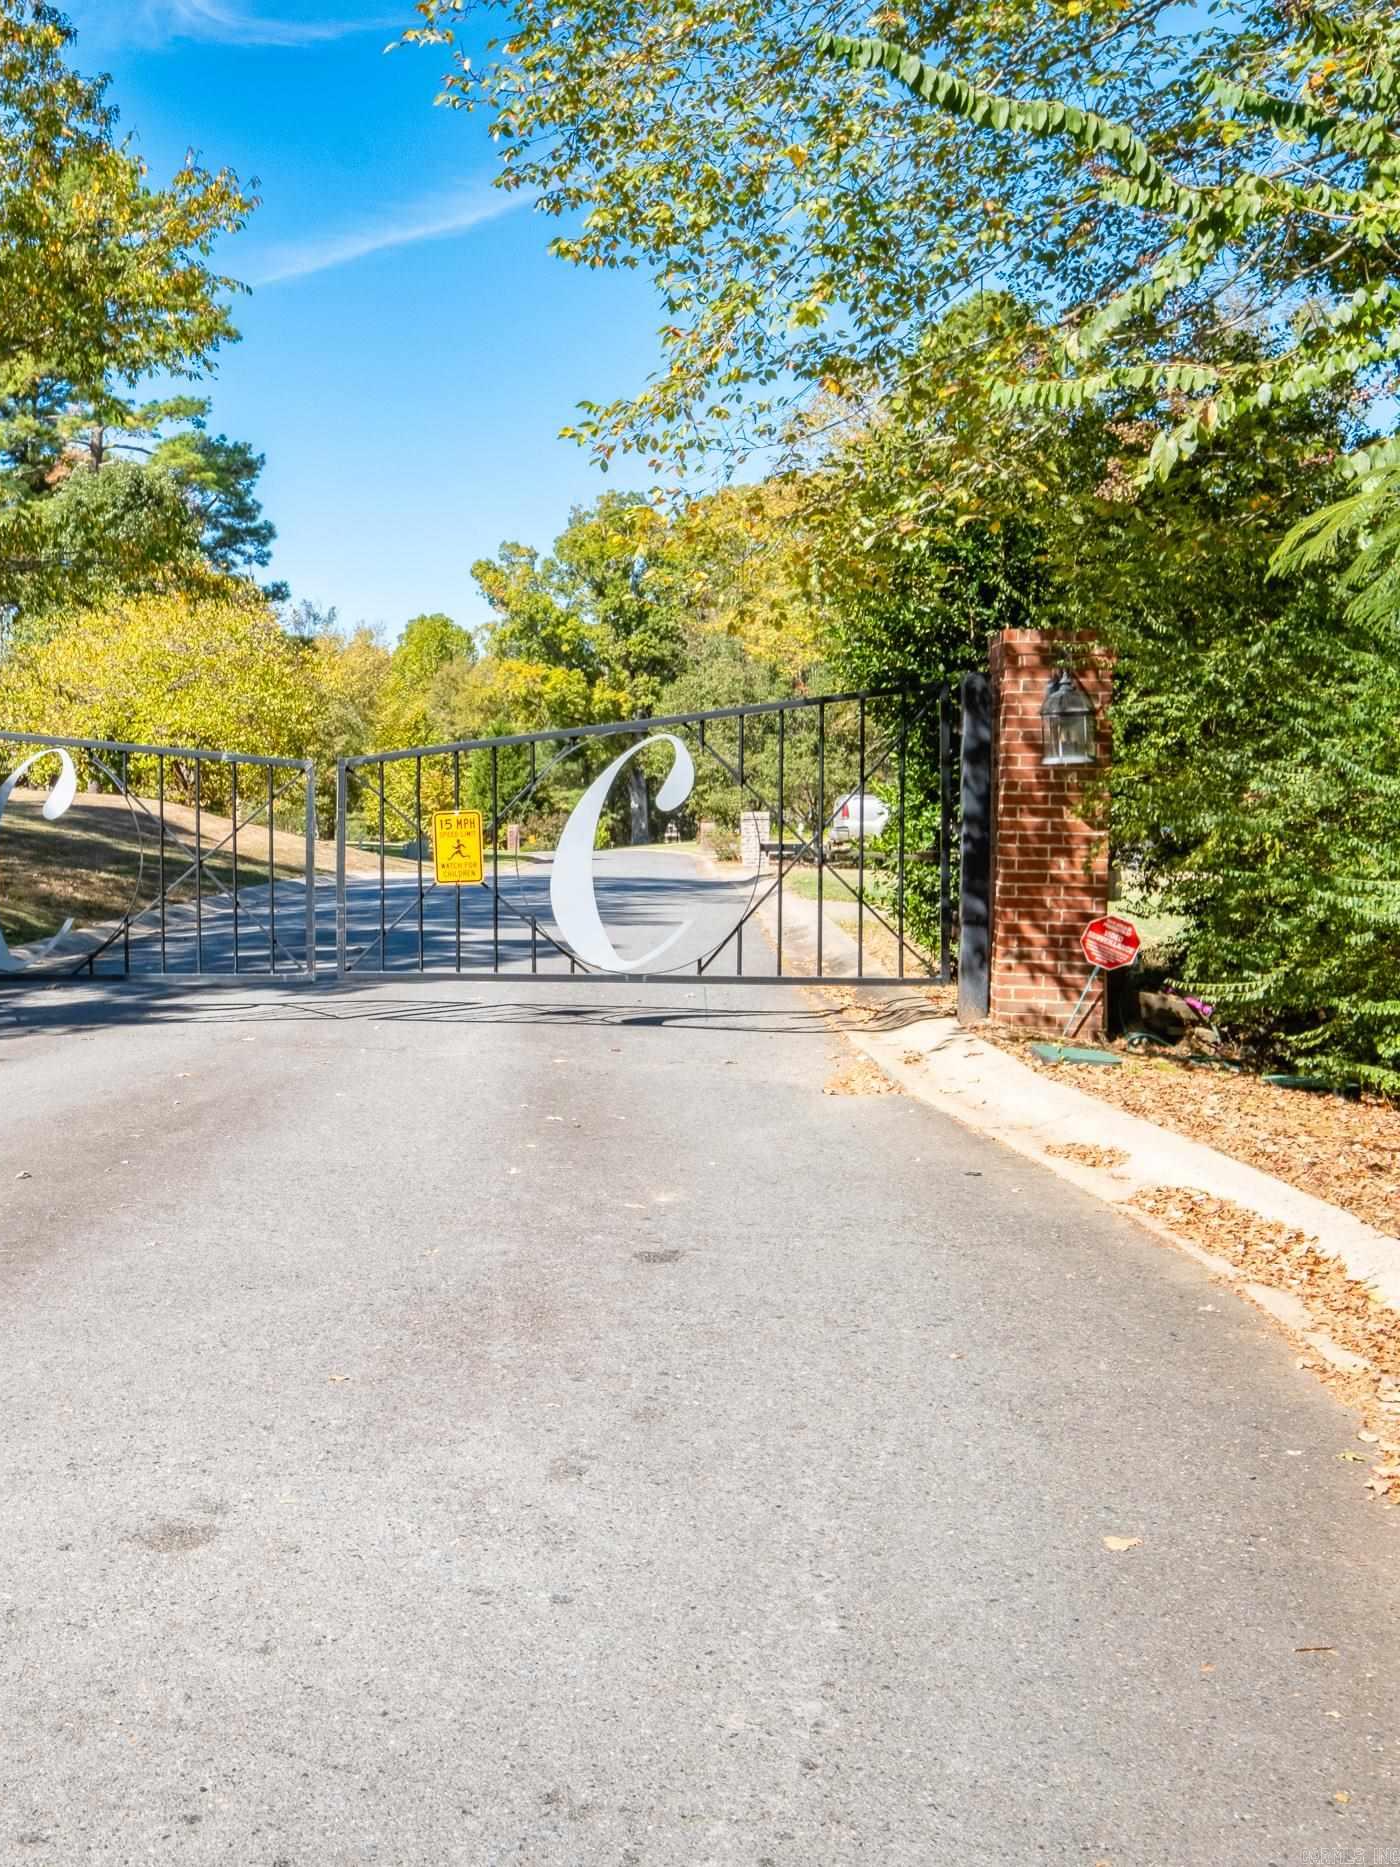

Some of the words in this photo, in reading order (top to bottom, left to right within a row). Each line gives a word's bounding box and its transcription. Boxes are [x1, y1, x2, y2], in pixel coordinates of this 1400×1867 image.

[440, 818, 453, 830] 15
[456, 817, 476, 830] MPH
[550, 733, 695, 972] C
[442, 870, 476, 878] CHILDREN
